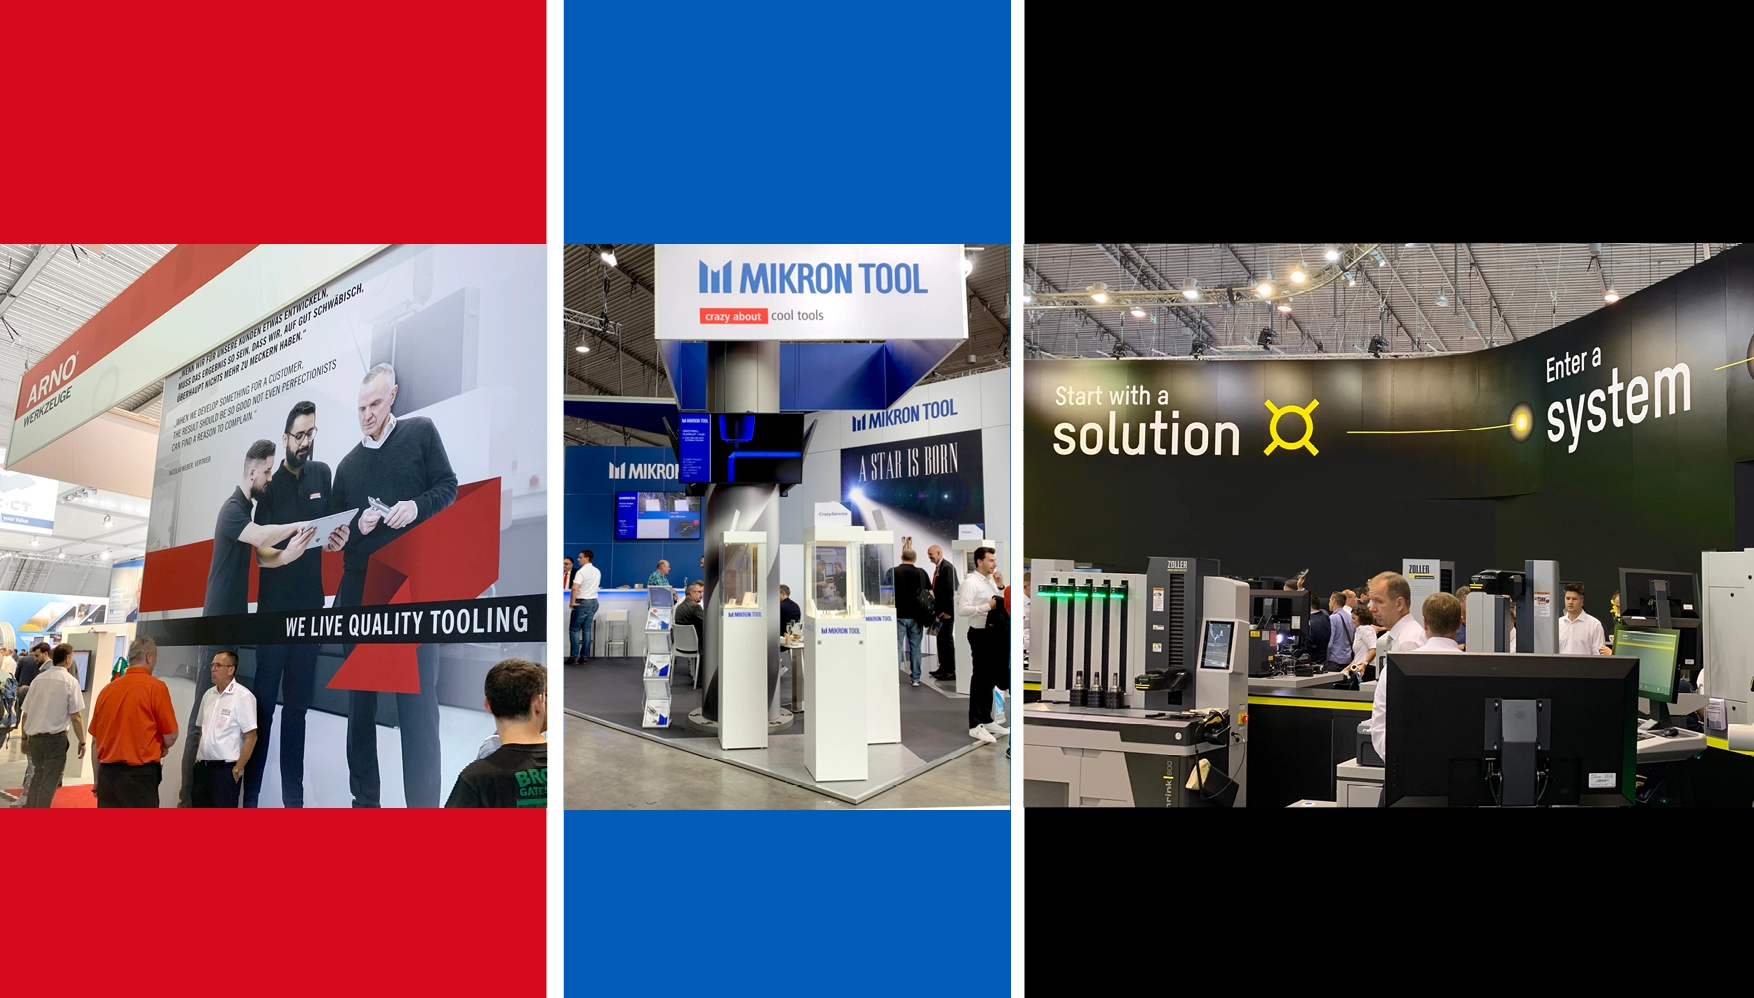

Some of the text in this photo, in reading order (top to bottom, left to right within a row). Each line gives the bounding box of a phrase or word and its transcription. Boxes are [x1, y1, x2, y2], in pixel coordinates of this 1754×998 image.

[740, 263, 928, 294] MIKRON TOOL
[196, 358, 206, 369] WIR
[217, 340, 238, 358] UNSERE
[239, 327, 262, 345] KUNDEN
[263, 314, 283, 332] ETWAS
[284, 288, 329, 320] ENTWICKELN,
[705, 308, 824, 323] crazy about cool tools
[178, 377, 192, 390] MUSS
[192, 371, 201, 383] DAS
[202, 358, 227, 378] ERGEBNIS
[228, 354, 236, 365] SO
[251, 337, 267, 351] DASS
[284, 319, 297, 334] AUF
[298, 311, 312, 326] GUT
[313, 282, 365, 318] SCHWÄBISCH,
[26, 354, 77, 408] ARNO
[176, 382, 204, 402] ÜBERHAUPT
[205, 372, 223, 388] NICHTS
[224, 364, 240, 379] MEHR
[240, 359, 249, 371] ZU
[249, 343, 279, 366] MECKERN
[1546, 346, 1602, 383] Enter a
[23, 386, 72, 428] WERKZEUGE
[173, 358, 338, 440] THE RESULT SHOULD BE SO GOOD NOT EVEN PERFECTIONISTS
[190, 408, 198, 420] WE
[197, 400, 219, 417] DEVELOP
[219, 385, 250, 407] SOMETHING
[250, 379, 262, 392] FOR
[262, 376, 268, 387] A
[268, 360, 304, 384] CUSTOMER,
[1055, 385, 1169, 406] Start with a
[1547, 362, 1691, 454] system
[868, 398, 958, 430] MIKRON TOOL
[1053, 410, 1240, 456] solution
[171, 442, 181, 452] CAN
[181, 436, 193, 449] FIND
[192, 435, 197, 444] A
[196, 426, 217, 442] REASON
[217, 423, 226, 434] TO
[860, 442, 958, 482] A STAR IS BORN
[1167, 560, 1187, 569] ZOLLER
[1408, 564, 1430, 574] ZOLLER
[285, 605, 528, 637] WE LIVE QUALITY TOOLING
